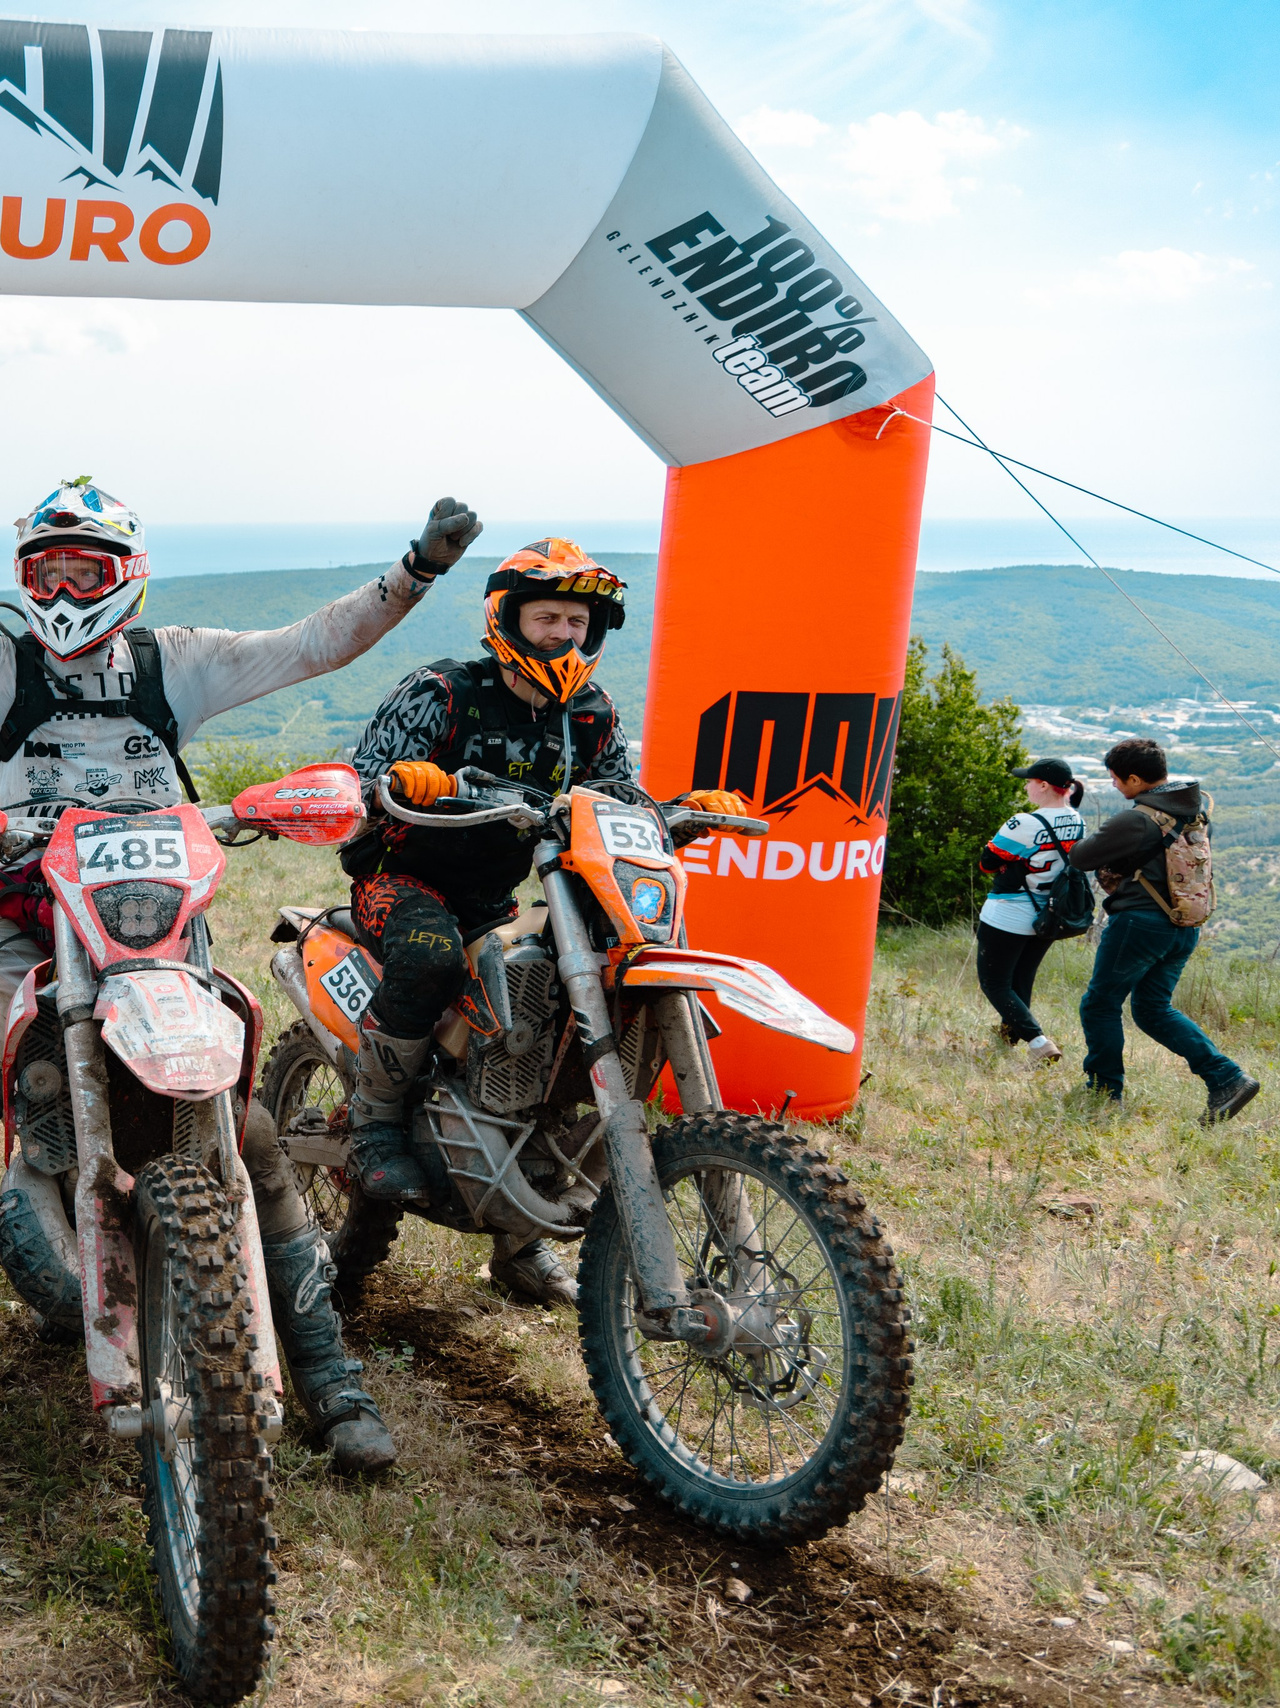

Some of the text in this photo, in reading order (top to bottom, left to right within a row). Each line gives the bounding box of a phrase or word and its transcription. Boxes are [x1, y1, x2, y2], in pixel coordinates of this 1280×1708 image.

[606, 229, 720, 346] GELENDZHIK
[644, 210, 868, 408] ENDURO
[740, 214, 878, 355] 100%
[711, 332, 813, 419] team
[86, 837, 182, 873] 485
[407, 928, 453, 952] LET'S
[328, 965, 367, 1013] 536
[167, 1074, 216, 1084] ENDURO
